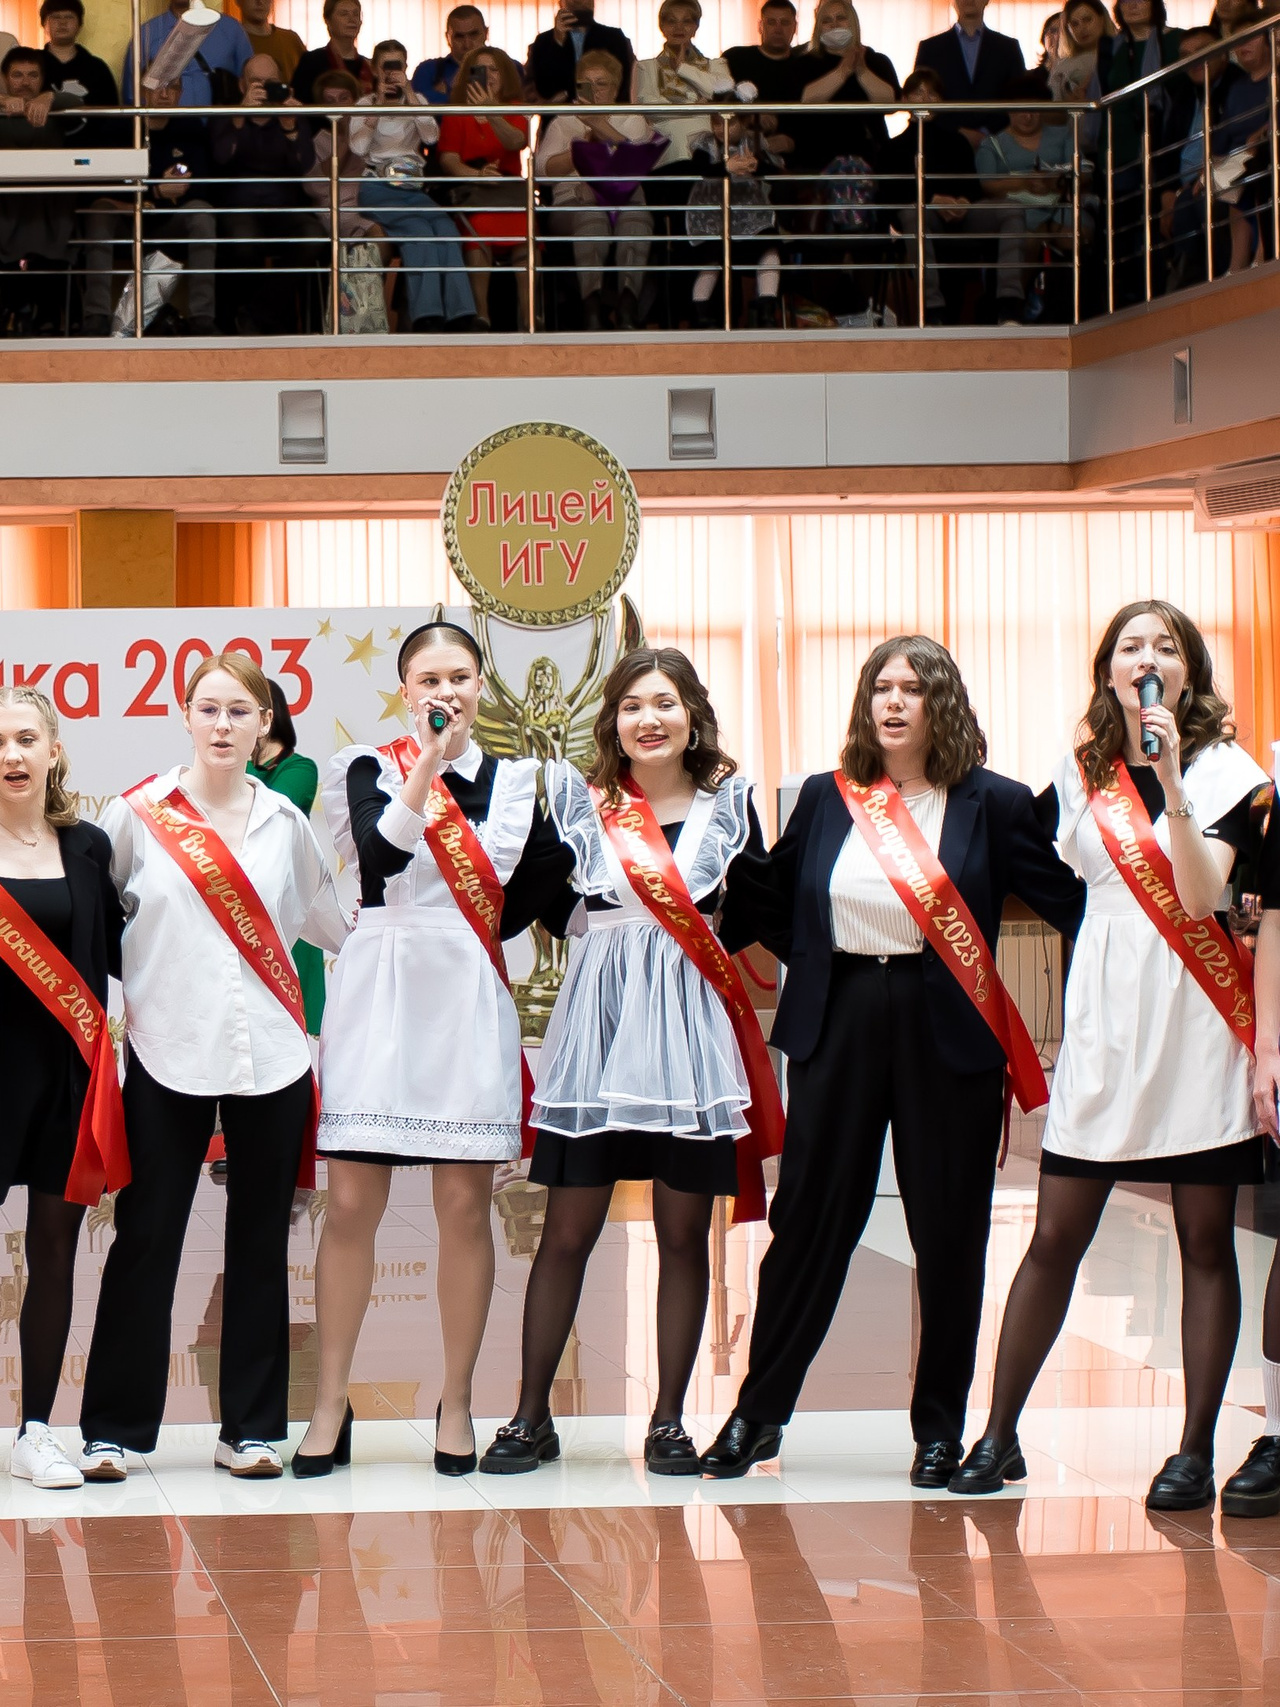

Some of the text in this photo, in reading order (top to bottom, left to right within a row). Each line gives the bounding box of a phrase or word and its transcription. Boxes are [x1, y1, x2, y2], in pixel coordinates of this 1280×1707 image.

[466, 479, 614, 532] Лицей
[500, 539, 588, 589] ИГУ
[178, 829, 300, 1004] Выпускник 2023
[862, 789, 980, 967] Выпускник 2023
[1107, 795, 1239, 988] Выпускник 2023
